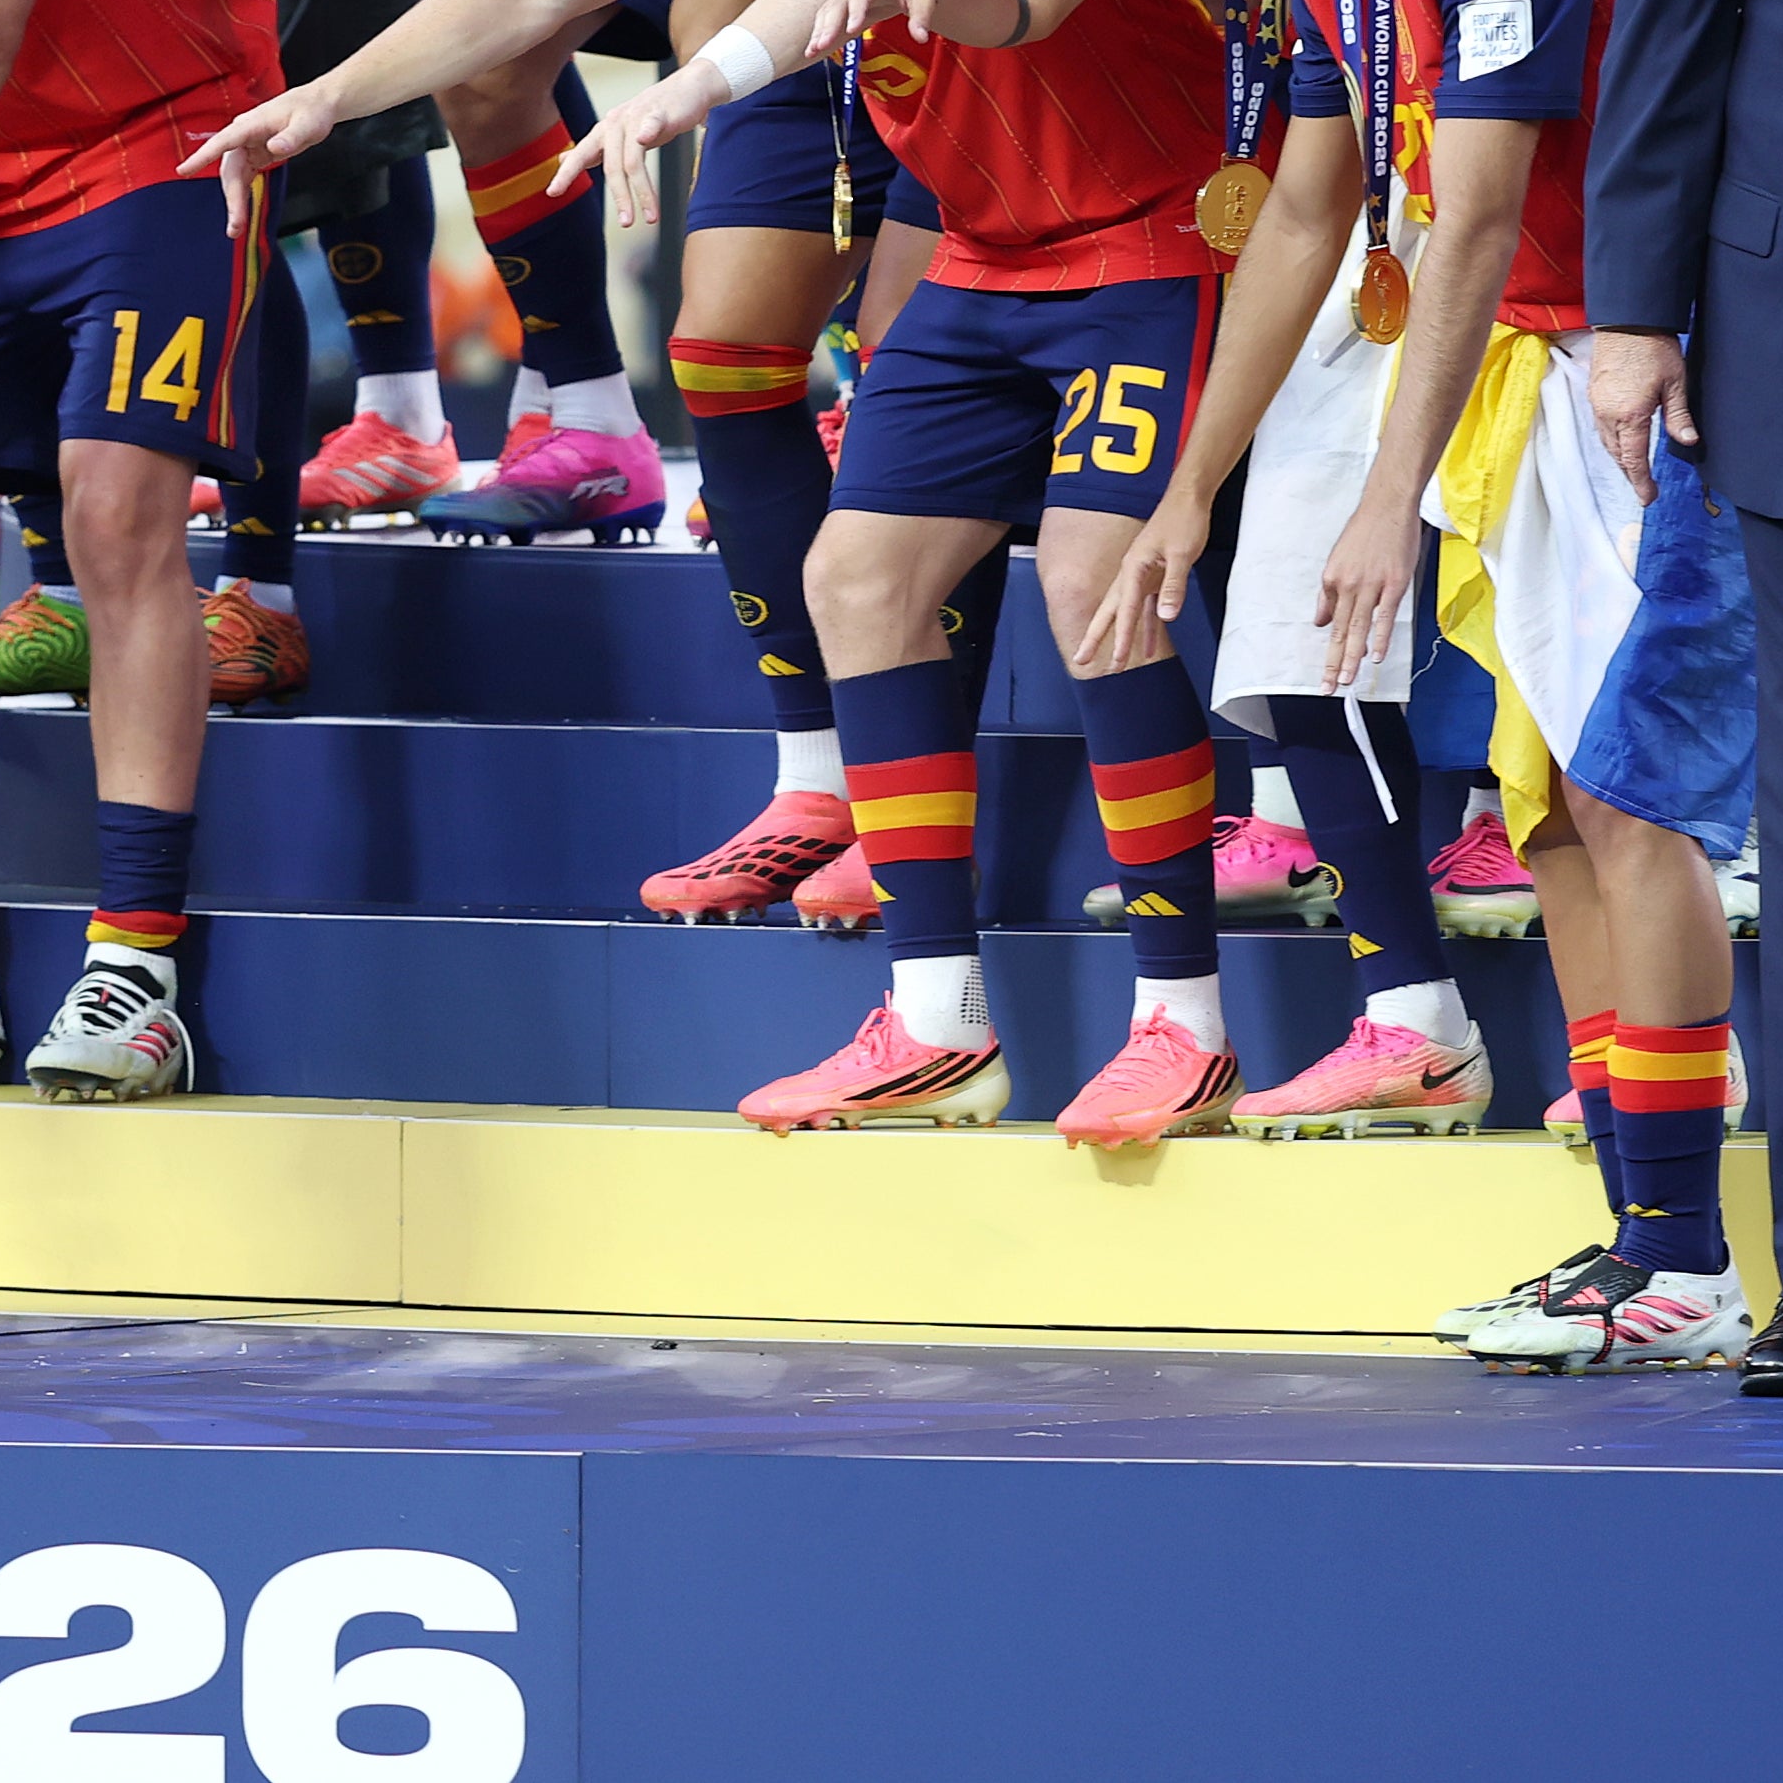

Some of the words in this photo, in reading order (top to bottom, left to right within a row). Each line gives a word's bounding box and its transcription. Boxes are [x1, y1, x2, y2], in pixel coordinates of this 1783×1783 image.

[1231, 41, 1245, 110] 2026
[1374, 14, 1391, 76] WORLD
[843, 69, 855, 106] FIFA
[1242, 82, 1265, 141] 2026
[1374, 77, 1390, 114] CUP
[1373, 114, 1388, 177] 2026
[105, 310, 206, 423] 14
[1050, 364, 1166, 476] 25
